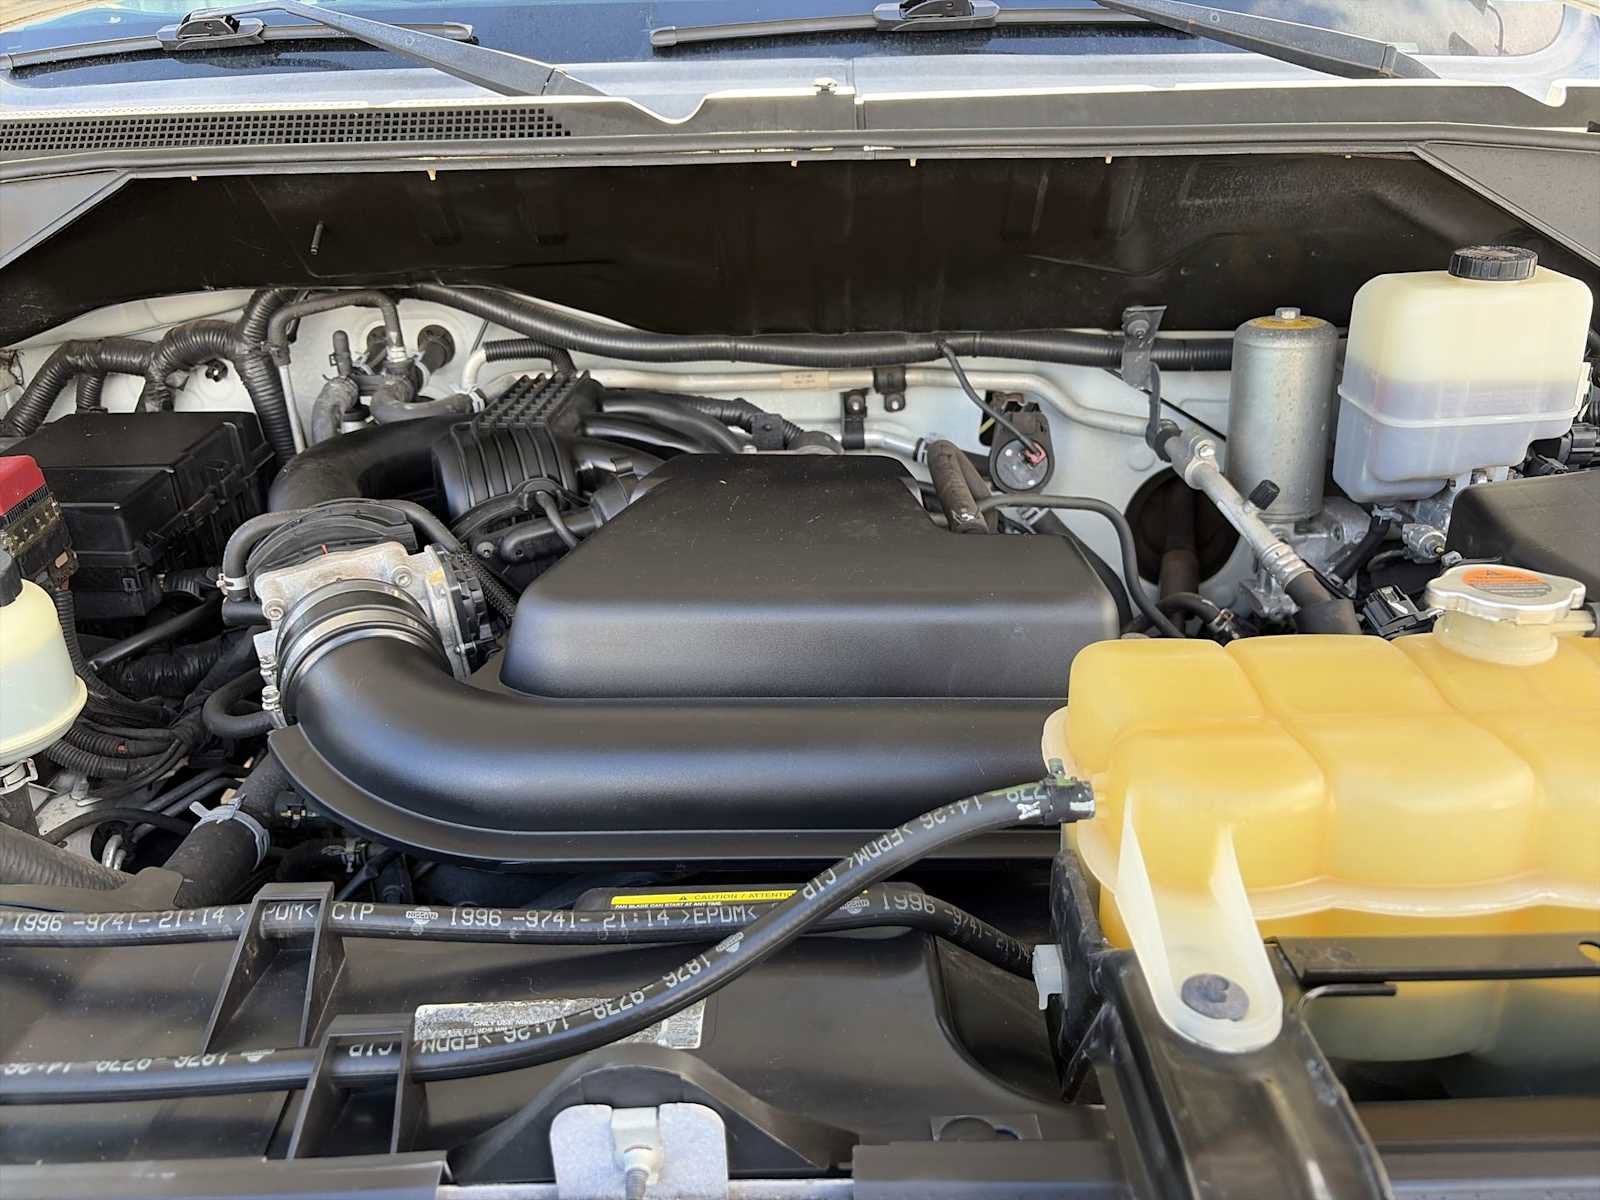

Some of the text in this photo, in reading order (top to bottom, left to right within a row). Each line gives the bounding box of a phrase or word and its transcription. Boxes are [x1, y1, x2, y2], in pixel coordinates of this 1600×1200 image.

[694, 893, 738, 901] CAUTION
[748, 890, 791, 899] ATTENTI
[882, 893, 936, 914] 1996
[13, 912, 63, 932] 1996
[331, 903, 375, 921] CIP
[450, 908, 502, 927] 1996
